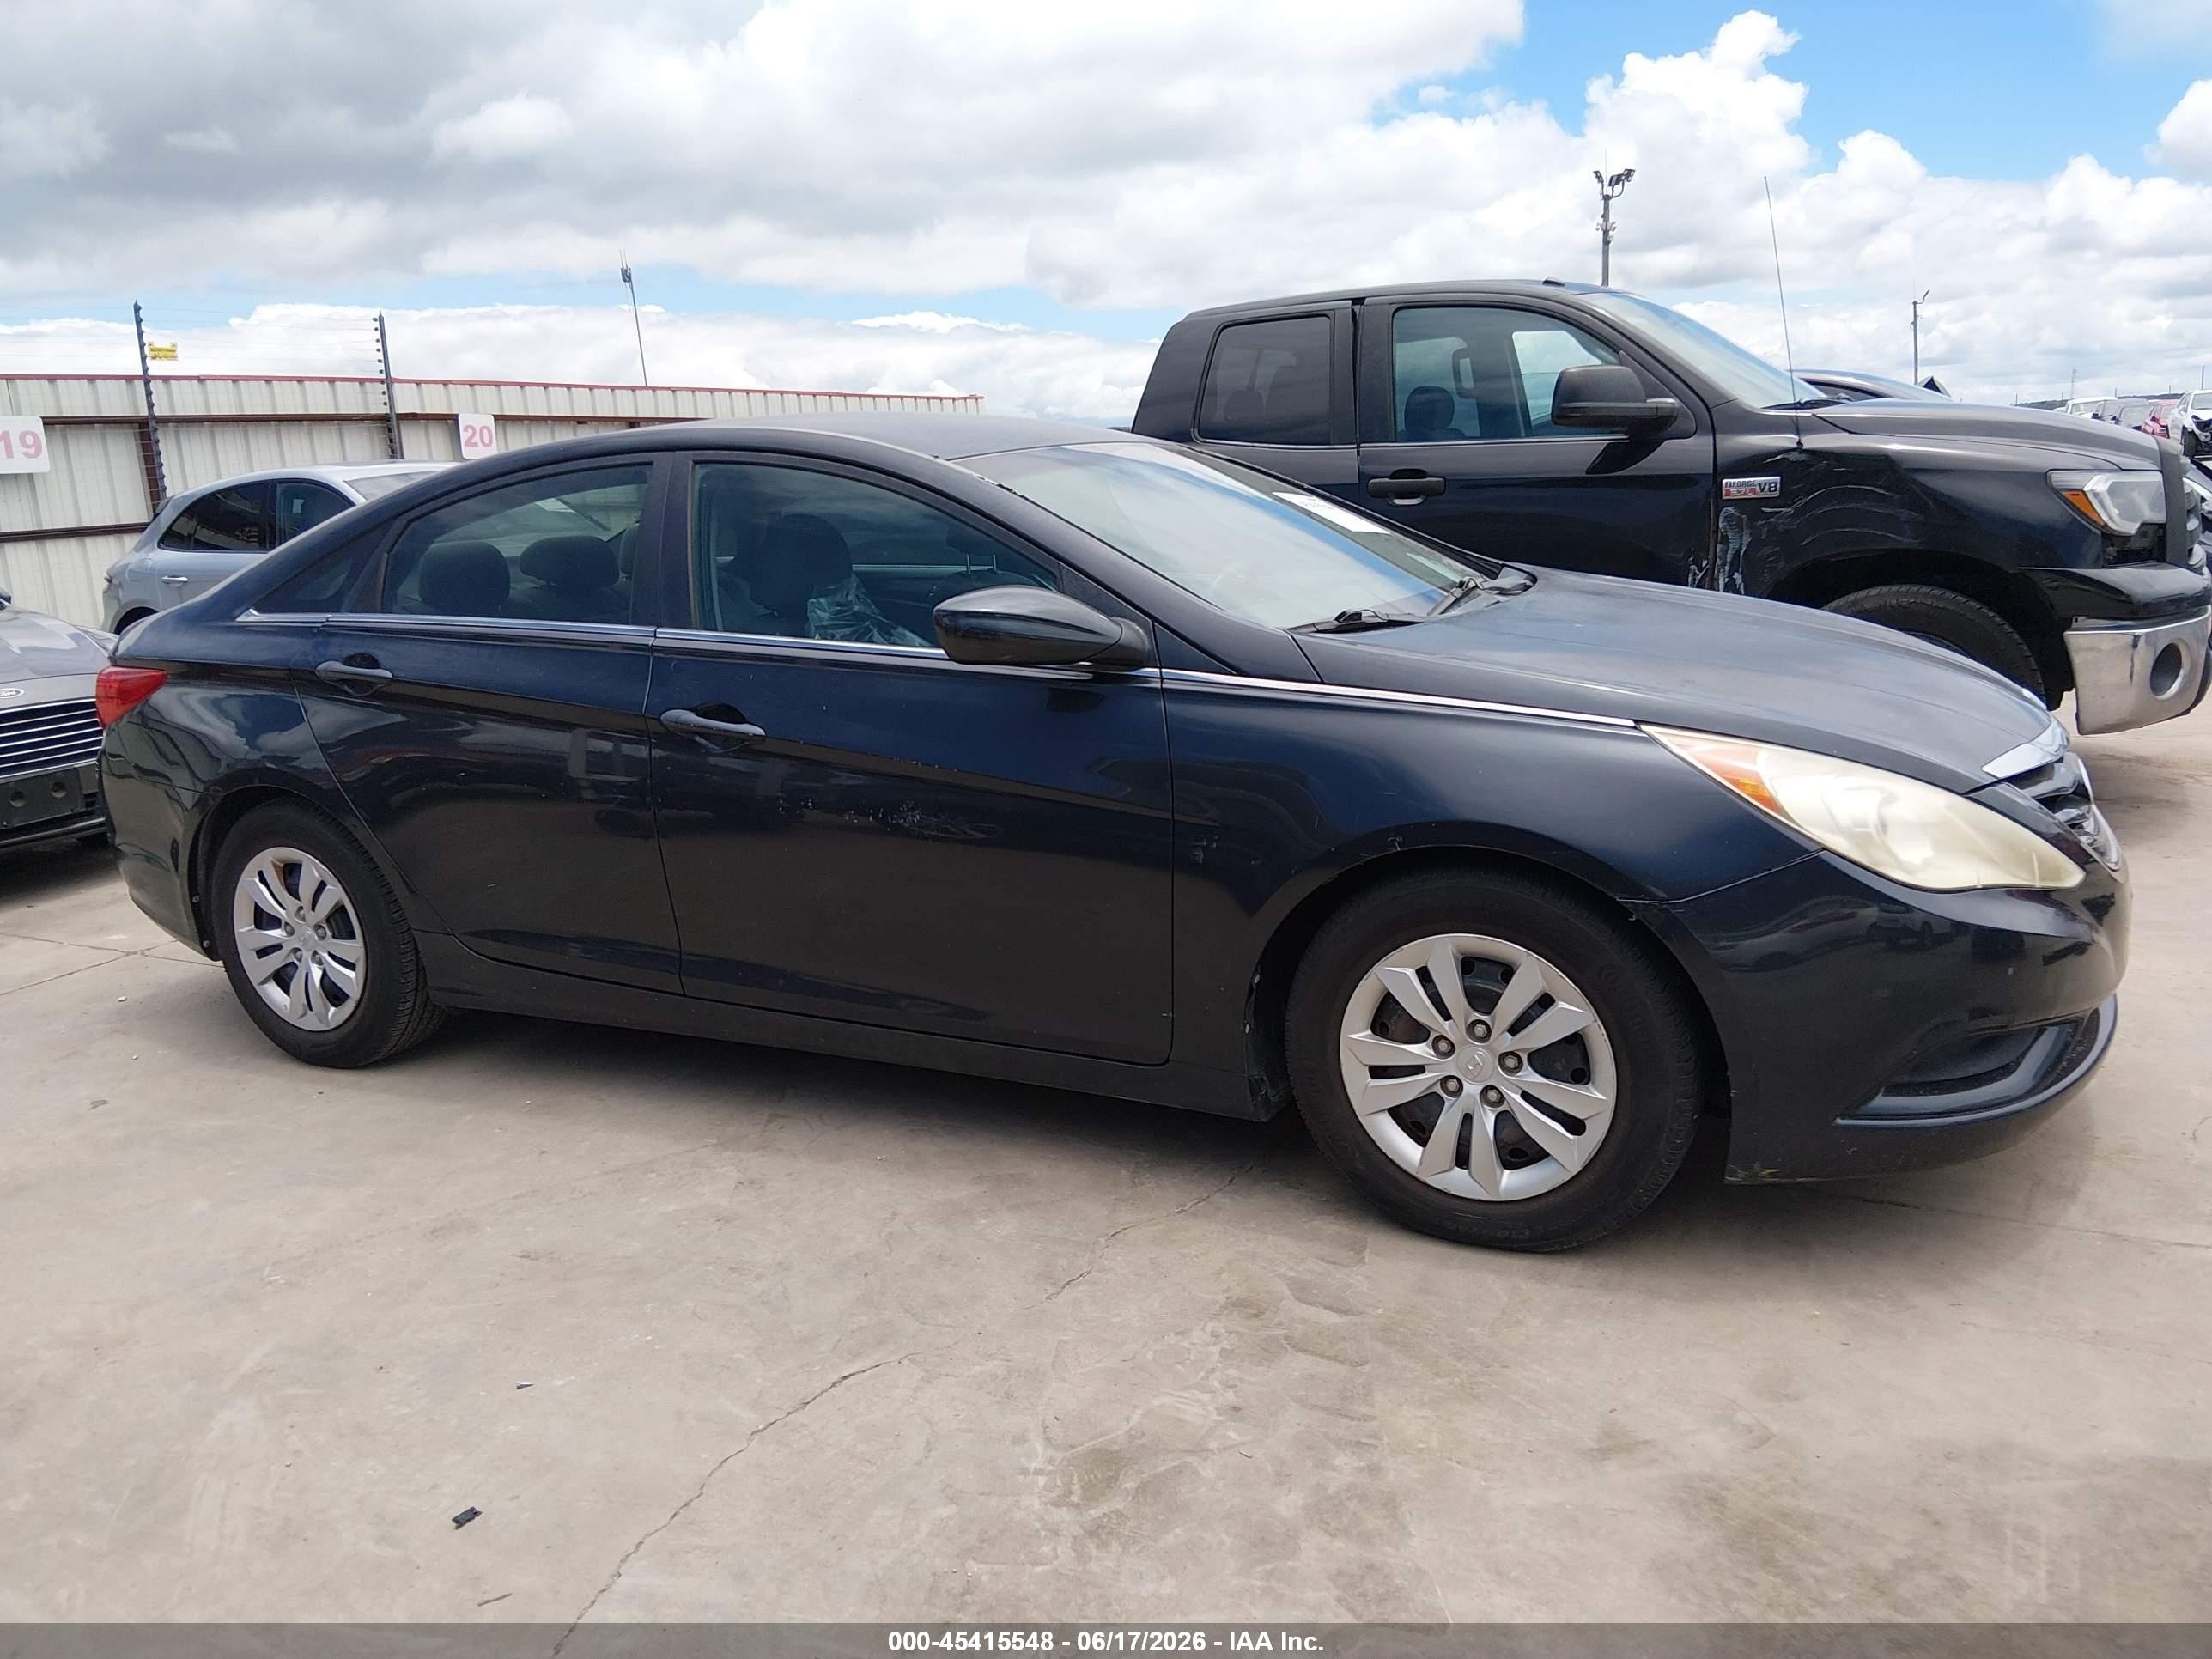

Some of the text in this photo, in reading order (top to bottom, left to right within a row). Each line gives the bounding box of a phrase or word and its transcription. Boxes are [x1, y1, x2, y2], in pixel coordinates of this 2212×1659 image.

[0, 429, 43, 459] 19
[463, 424, 494, 447] 20
[1758, 482, 1778, 493] V8
